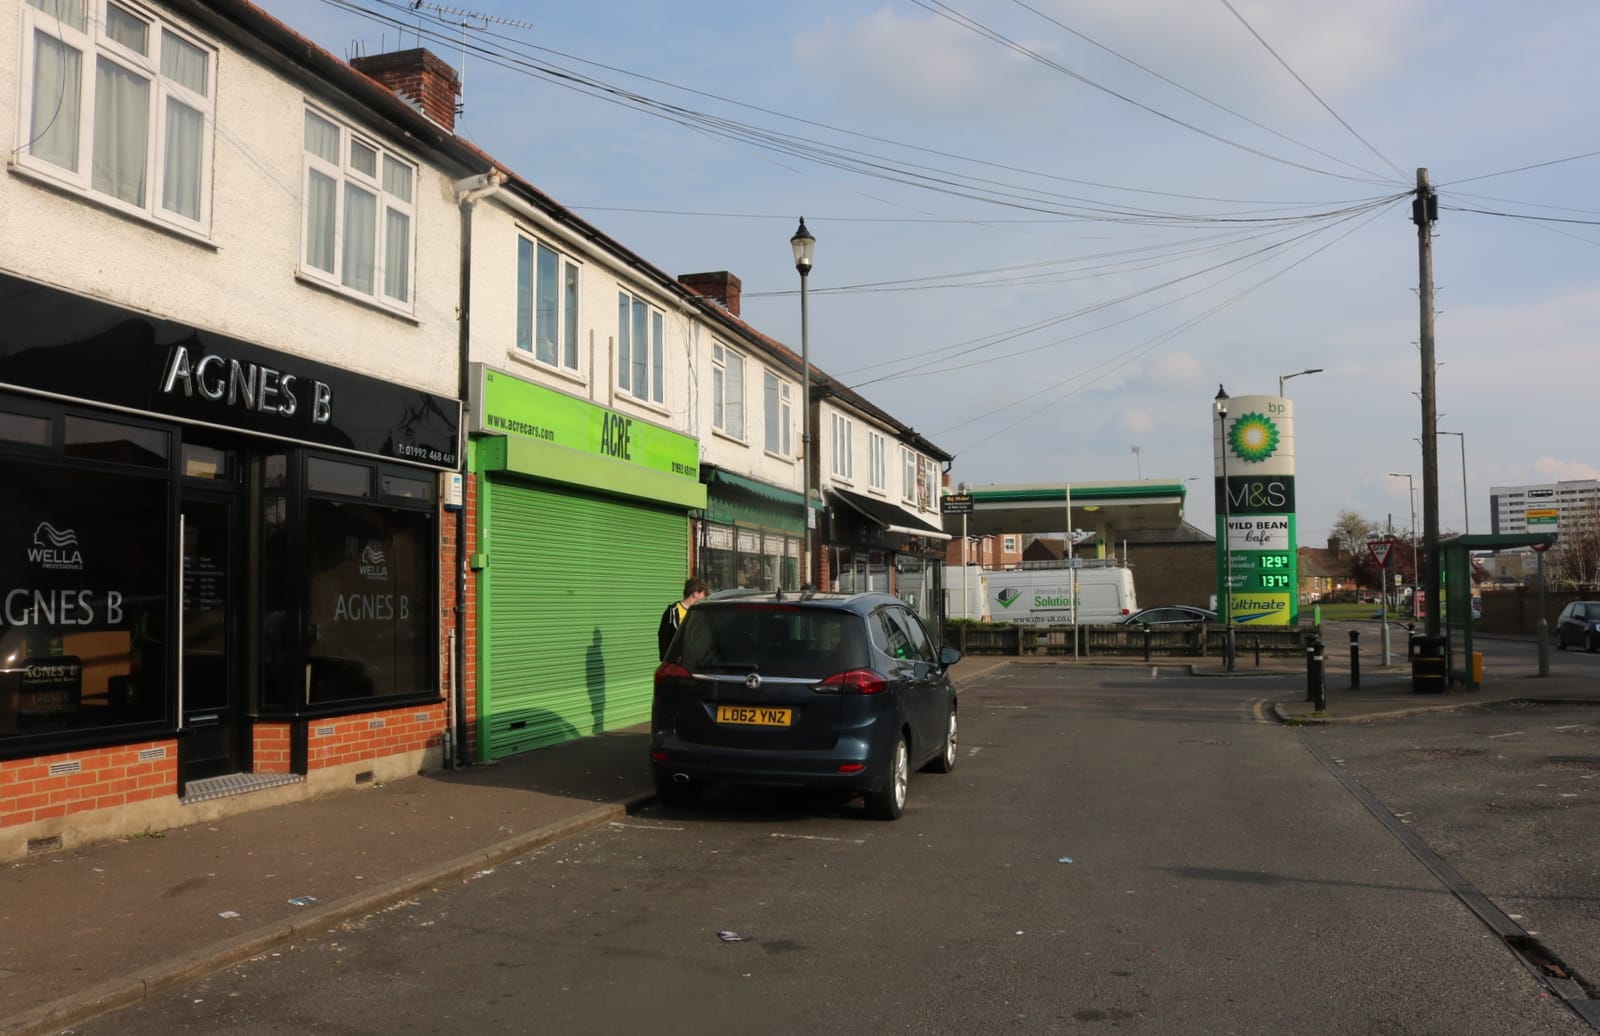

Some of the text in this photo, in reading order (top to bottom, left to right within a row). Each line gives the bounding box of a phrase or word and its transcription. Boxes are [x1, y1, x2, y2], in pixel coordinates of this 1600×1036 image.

[161, 345, 332, 423] AGNES B
[1268, 402, 1284, 414] bp
[487, 414, 554, 441] www.acrecars.com
[600, 411, 632, 461] ACRE
[1226, 482, 1286, 507] M&S
[1256, 521, 1288, 530] BEAN
[27, 548, 83, 564] WELLA
[360, 565, 388, 576] WELLA
[0, 588, 123, 626] GNES B
[334, 593, 409, 621] AGNES B
[760, 710, 786, 723] YNZ
